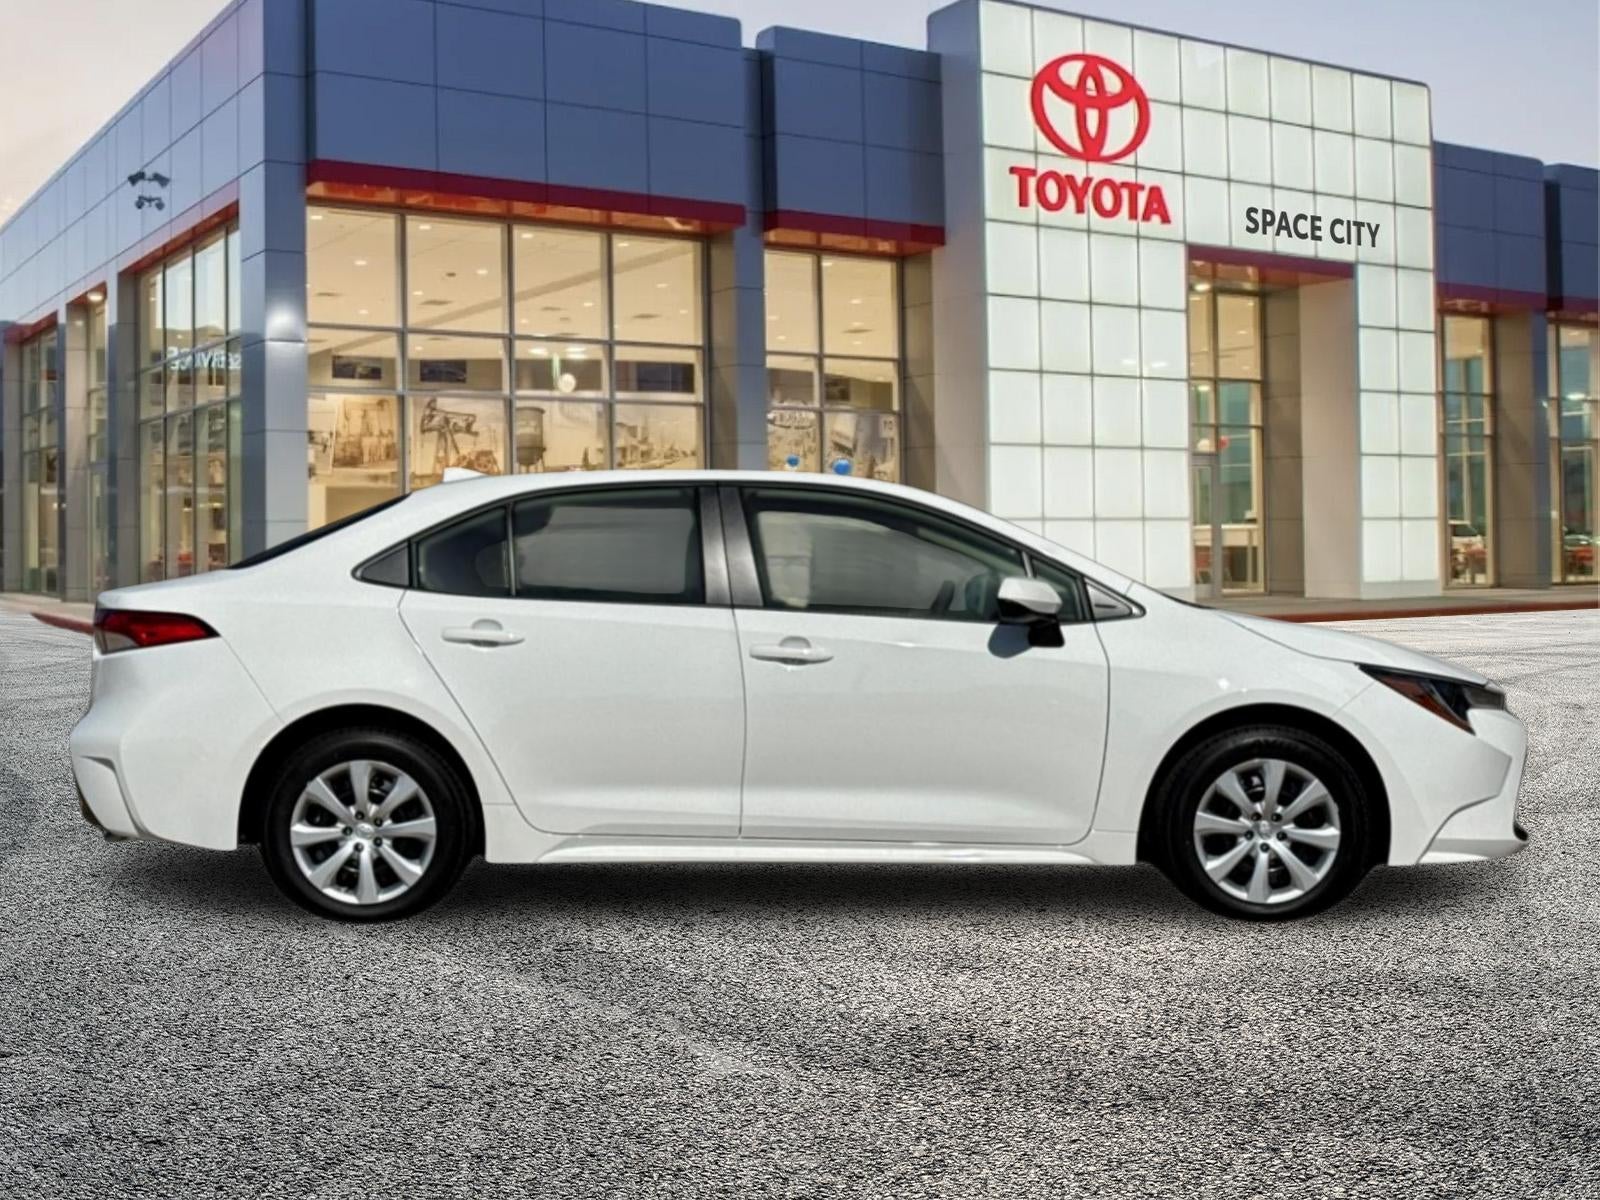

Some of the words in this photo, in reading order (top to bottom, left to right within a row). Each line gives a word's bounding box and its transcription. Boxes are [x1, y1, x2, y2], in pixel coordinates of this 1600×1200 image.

[1009, 166, 1171, 224] TOYOTA
[1245, 207, 1322, 242] SPACE
[1329, 218, 1380, 248] CITY
